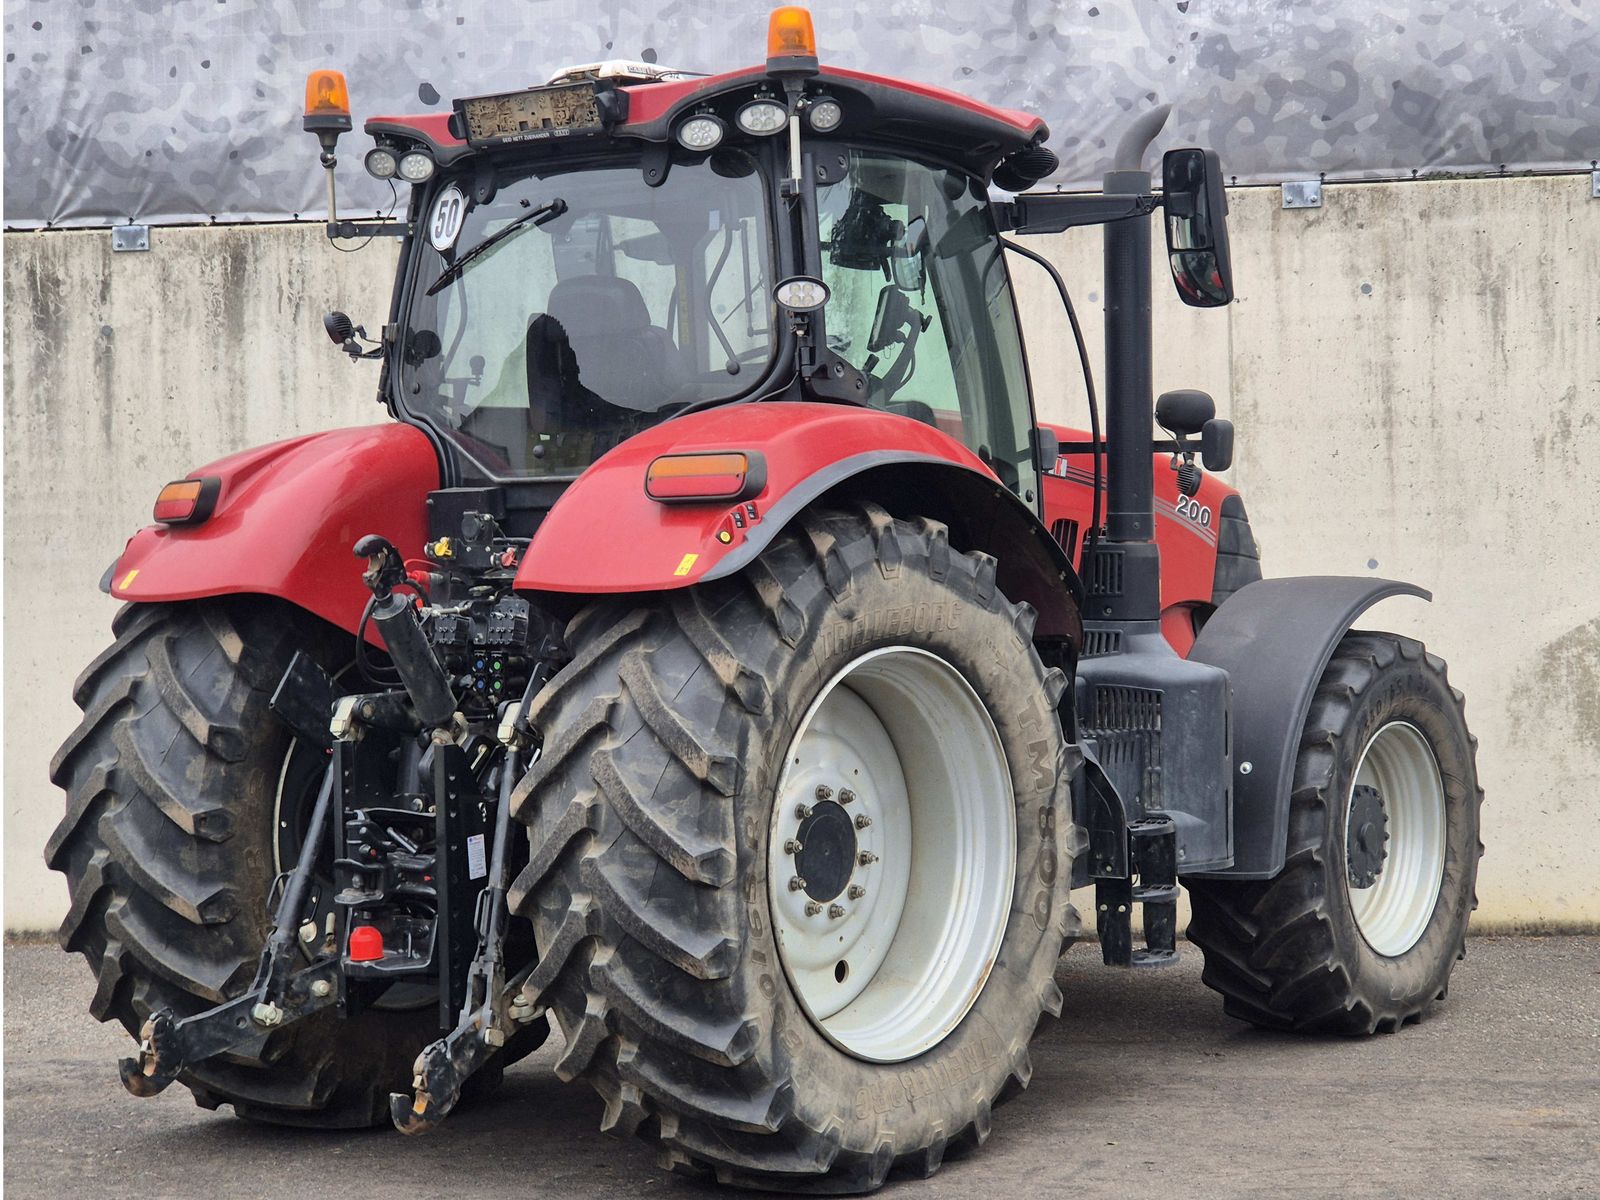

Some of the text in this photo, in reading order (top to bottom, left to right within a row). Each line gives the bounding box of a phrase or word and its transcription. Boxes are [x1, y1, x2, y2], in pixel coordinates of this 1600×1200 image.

[434, 198, 460, 239] 50
[1175, 493, 1212, 528] 200
[820, 601, 962, 661] TRELLEBORG
